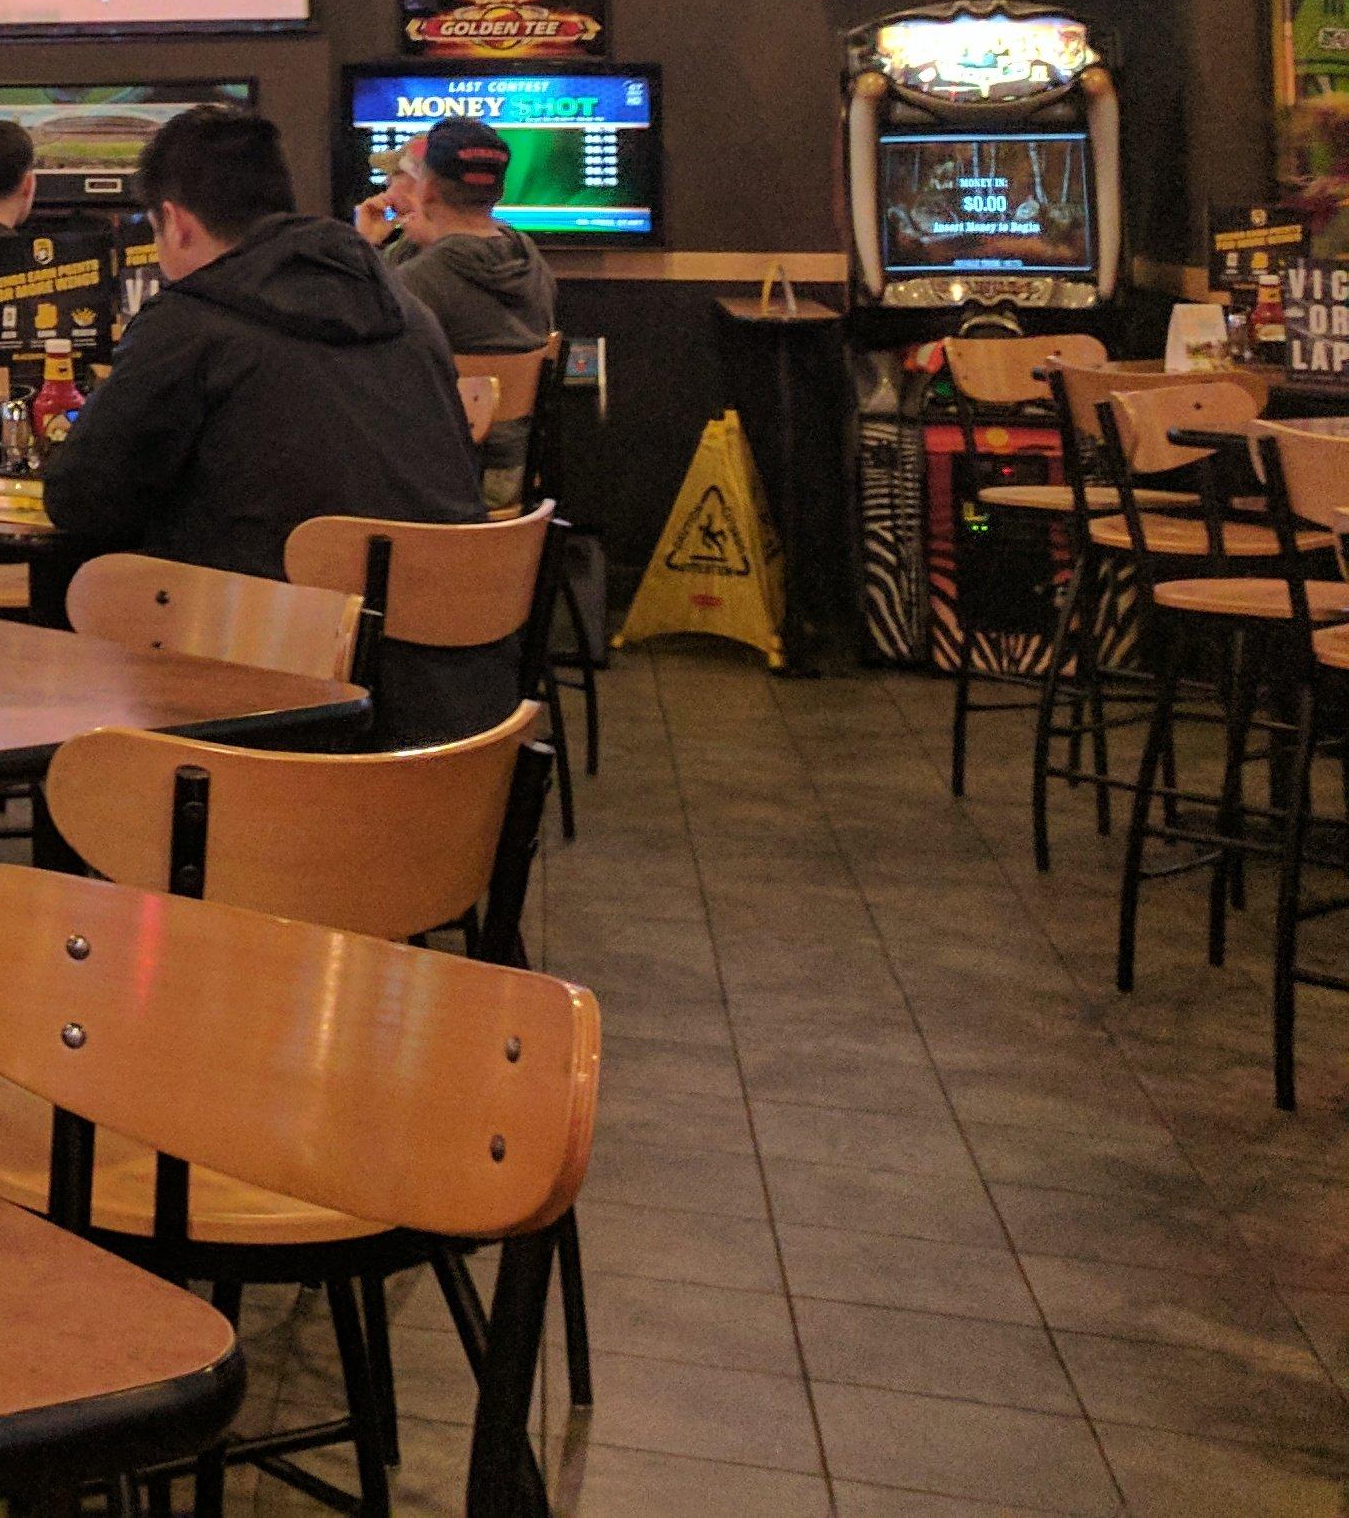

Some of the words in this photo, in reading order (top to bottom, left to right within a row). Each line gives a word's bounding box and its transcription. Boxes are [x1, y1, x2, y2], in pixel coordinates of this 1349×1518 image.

[440, 20, 519, 36] GOLDEN
[524, 20, 561, 36] TEE
[448, 81, 482, 93] LAST
[488, 81, 550, 93] CONTEST
[397, 96, 505, 119] MONEY
[510, 96, 600, 119] SHOT
[962, 195, 1008, 214] $0.00
